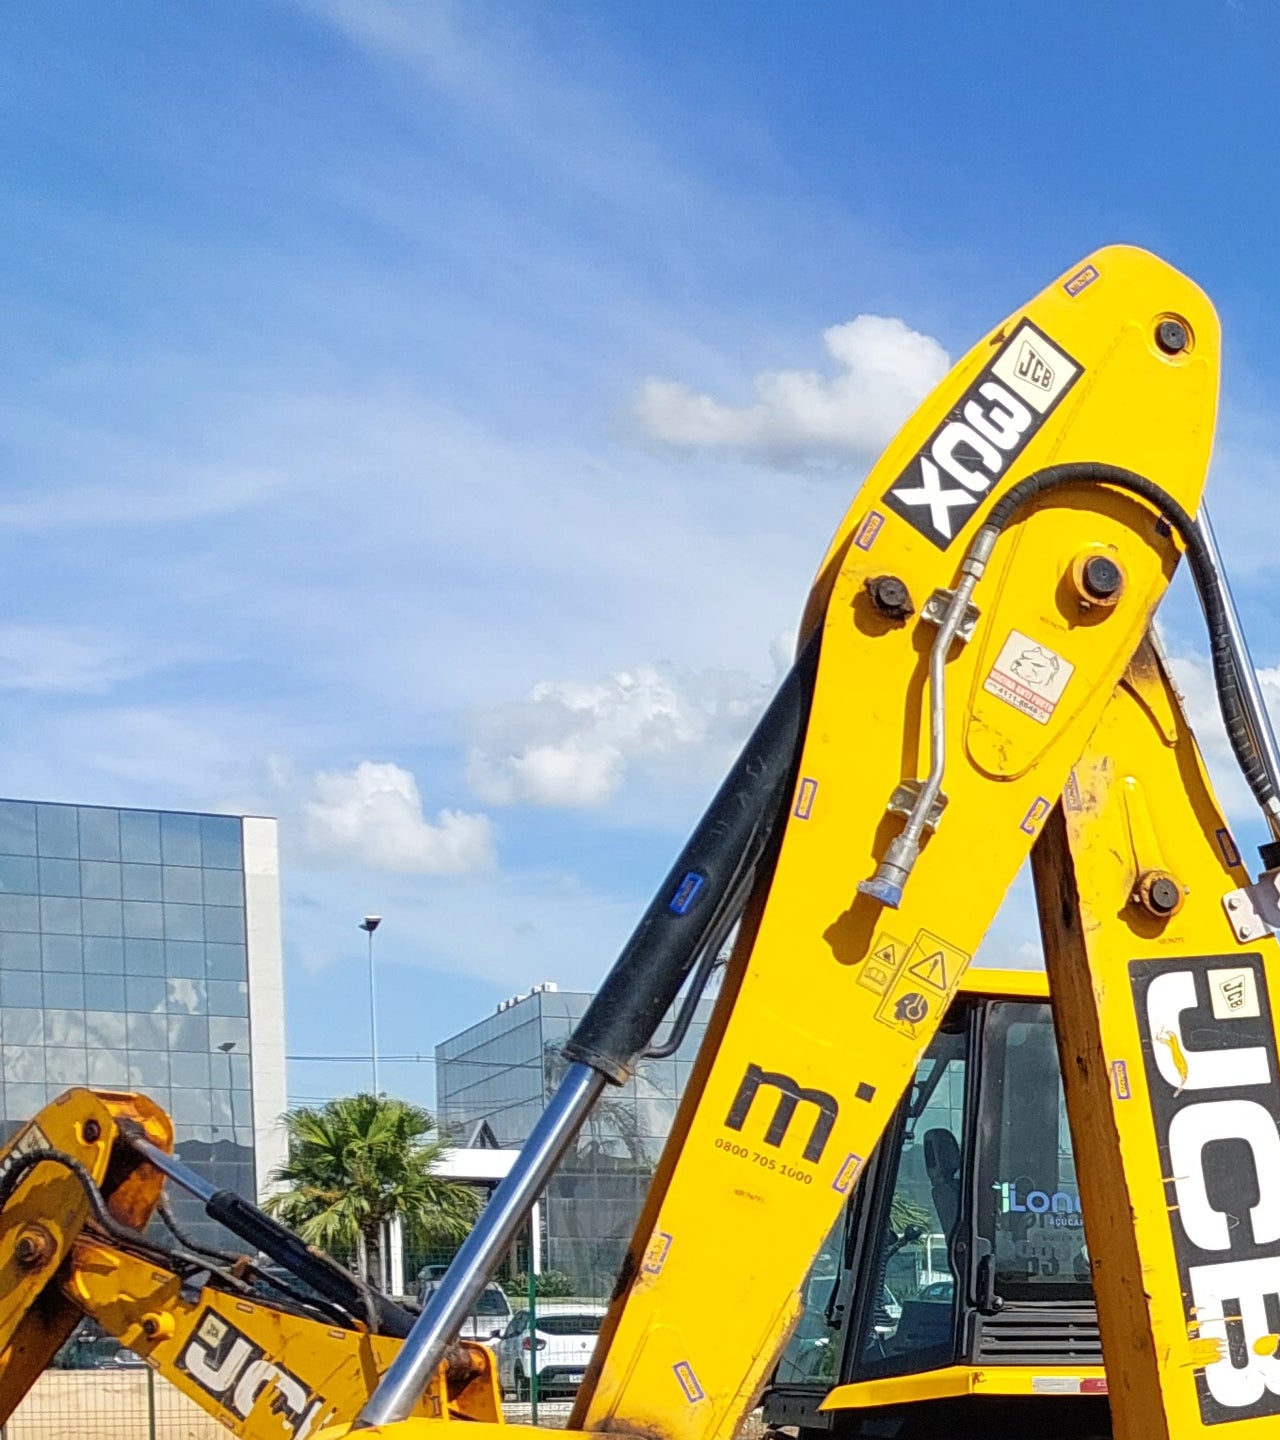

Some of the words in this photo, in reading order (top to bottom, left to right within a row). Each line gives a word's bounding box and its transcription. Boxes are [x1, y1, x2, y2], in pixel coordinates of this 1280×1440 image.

[1018, 350, 1053, 388] JCB
[892, 382, 1032, 539] 3CX
[1223, 981, 1243, 1009] JCB
[715, 1138, 749, 1158] 0800
[752, 1152, 776, 1170] 705
[779, 1164, 813, 1185] 1000
